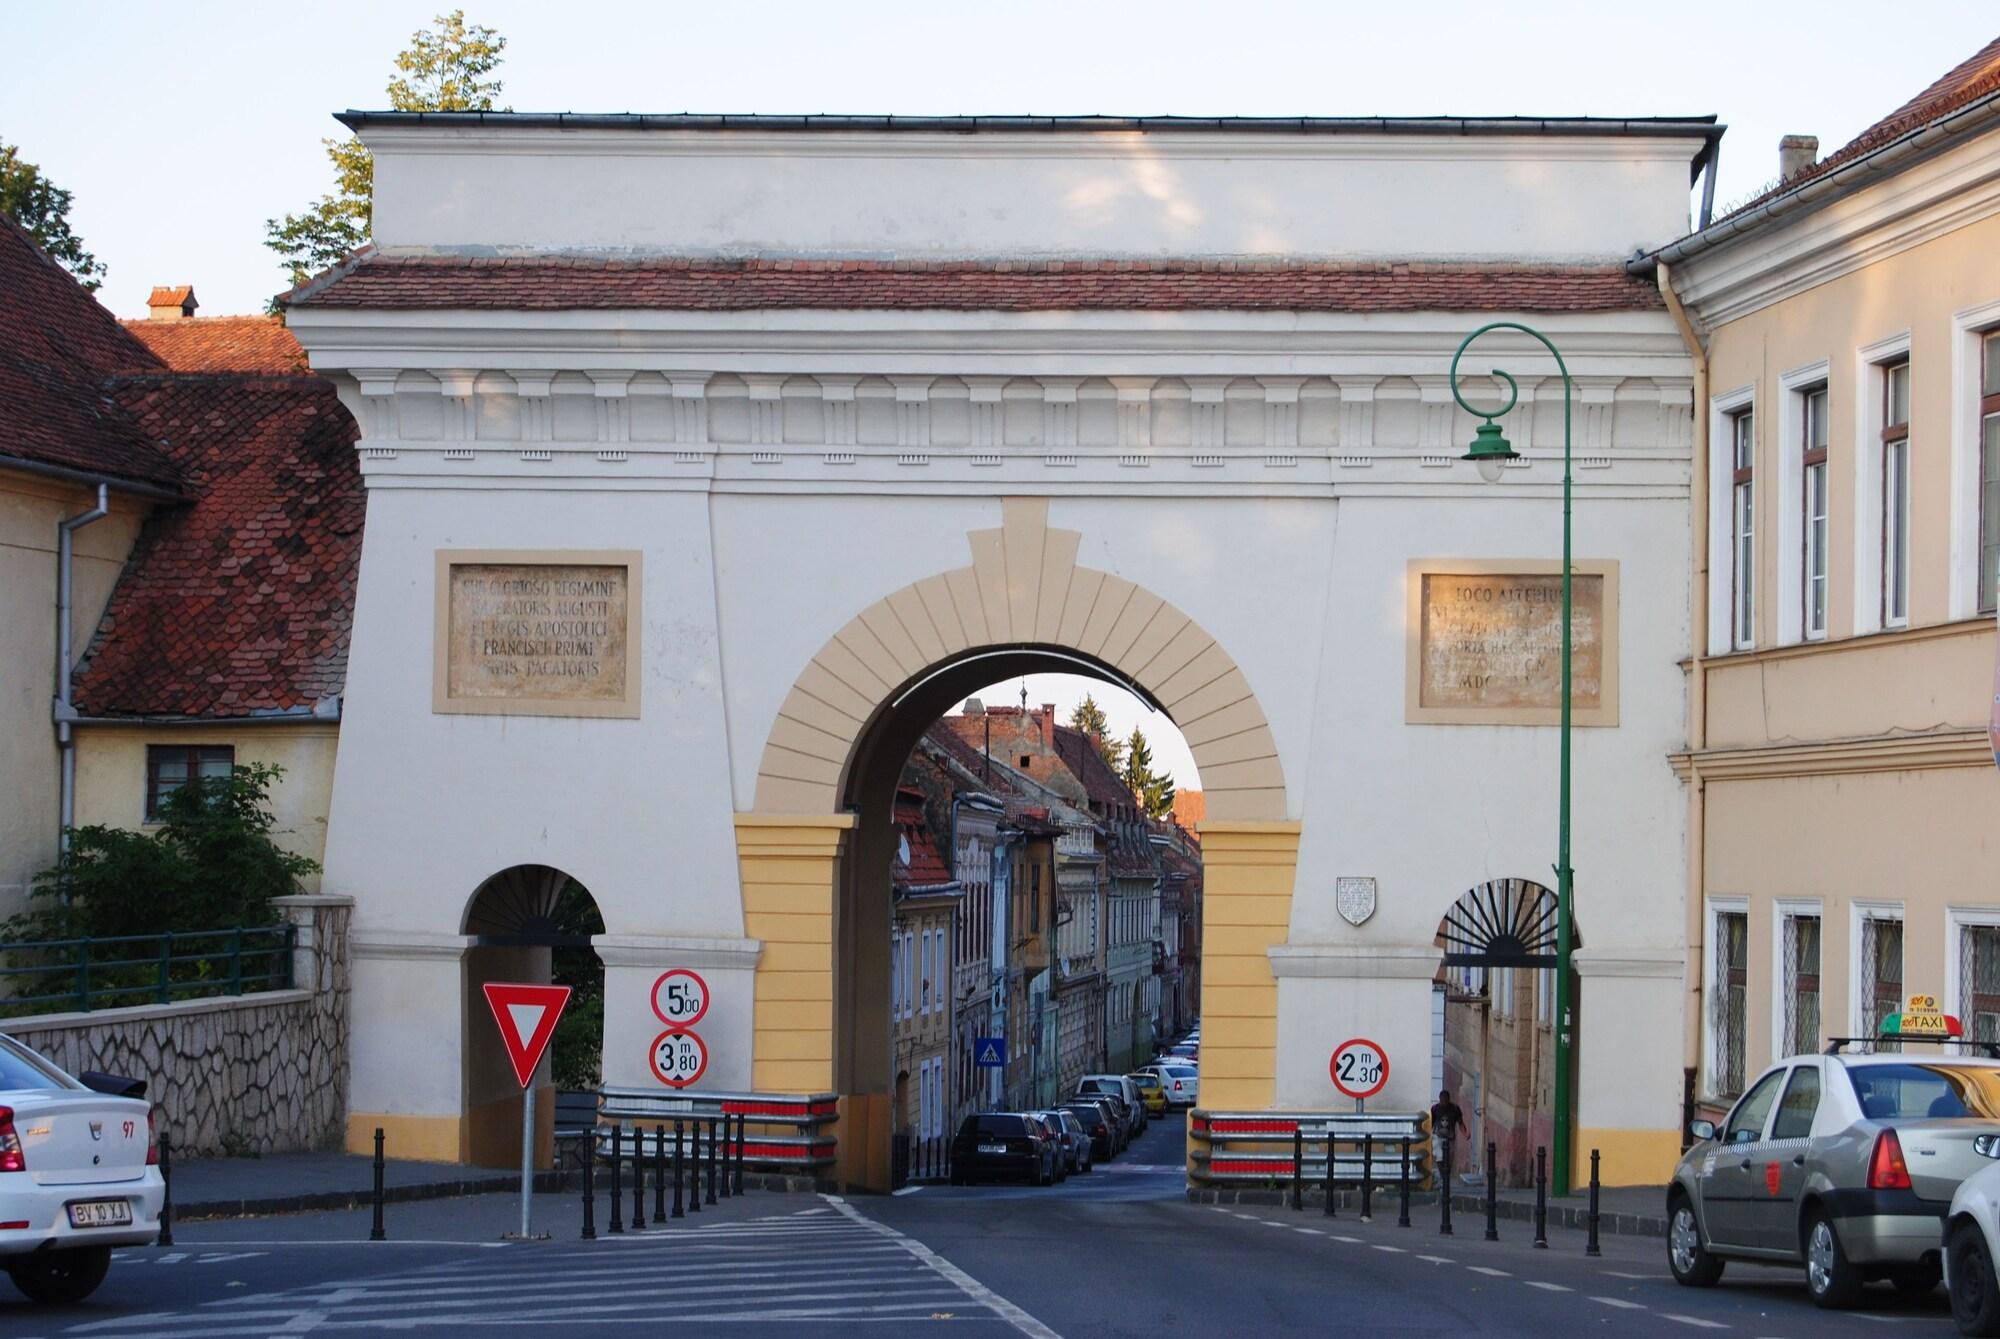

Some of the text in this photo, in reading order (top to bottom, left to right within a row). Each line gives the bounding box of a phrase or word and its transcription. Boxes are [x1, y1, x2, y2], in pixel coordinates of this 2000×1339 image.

[556, 580, 617, 598] REGIMINE
[1456, 587, 1492, 602] LOCO
[556, 600, 608, 617] AUGUSTI
[491, 620, 529, 637] REGIS
[535, 620, 607, 638] APOSTOLICI
[484, 640, 593, 656] FRANCISCI PRIMI
[526, 660, 600, 678] PACATORIS
[1912, 1015, 1943, 1028] TAXI
[123, 1121, 135, 1139] 97
[75, 1205, 92, 1222] BV
[95, 1204, 107, 1221] 10
